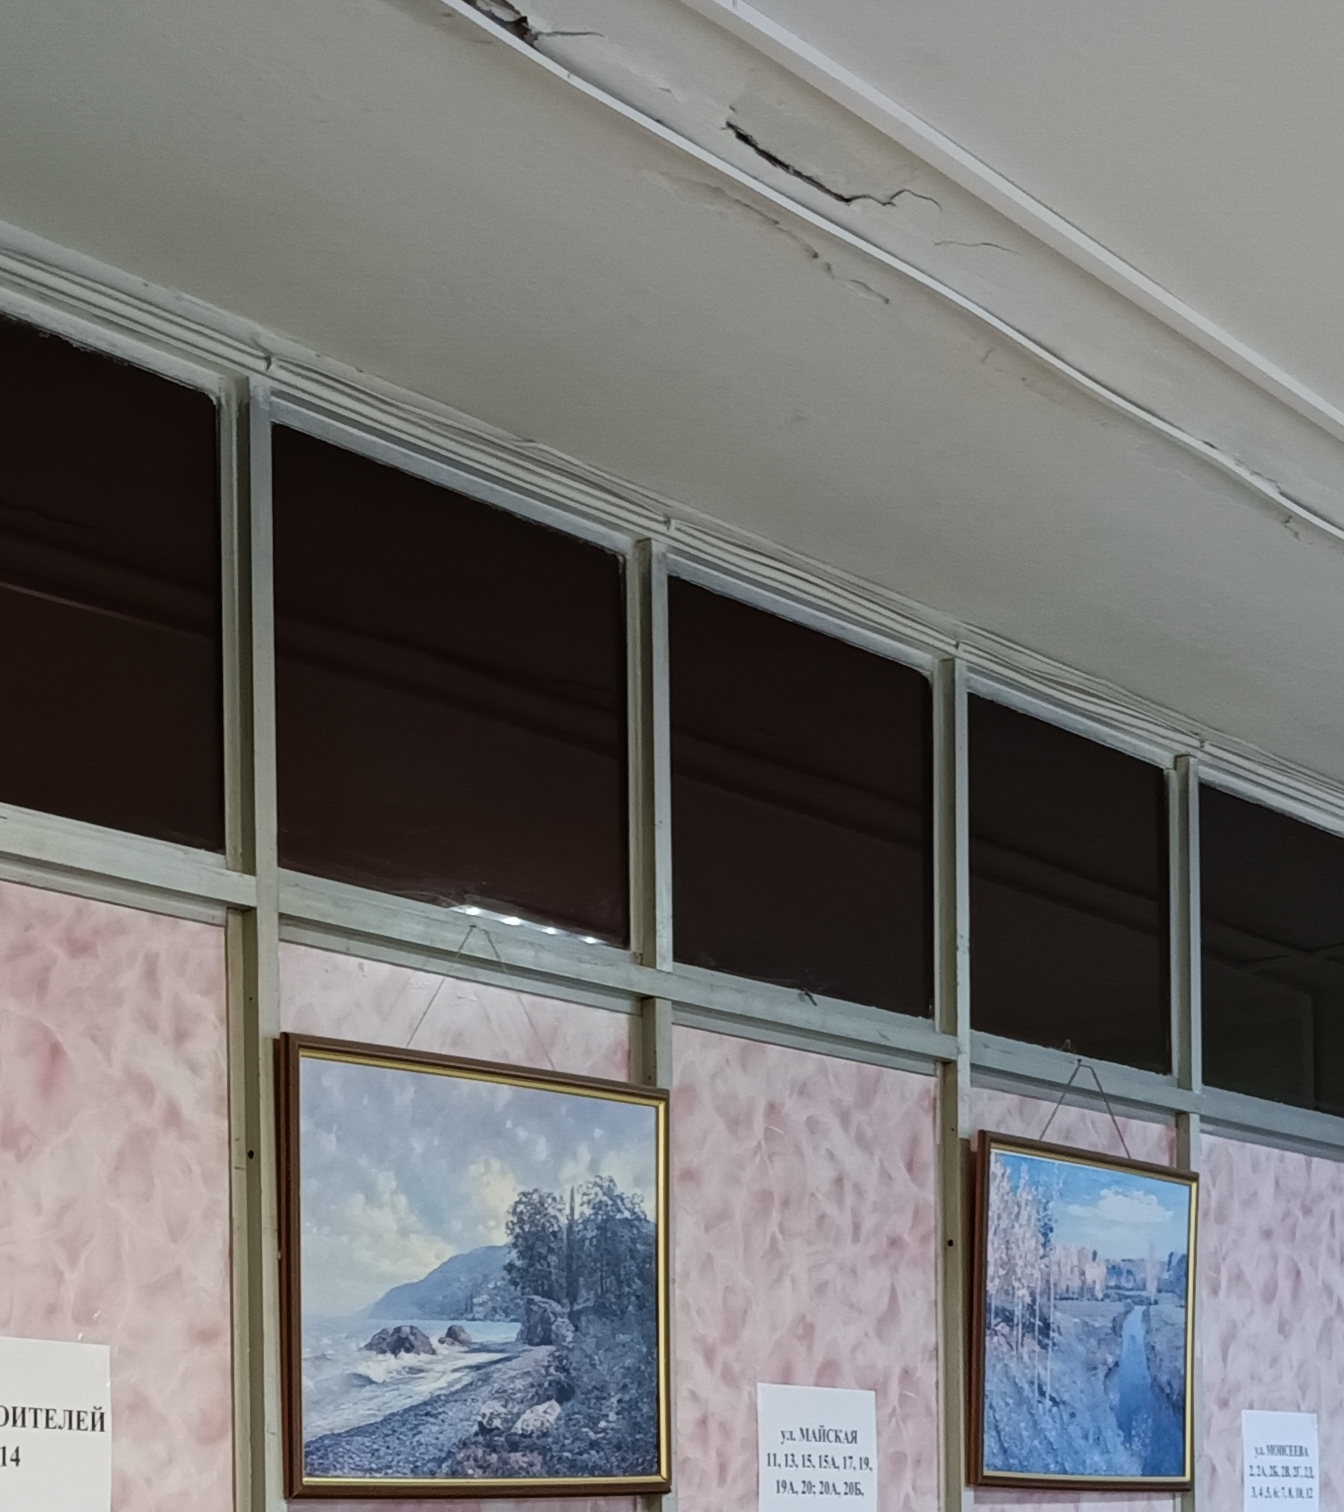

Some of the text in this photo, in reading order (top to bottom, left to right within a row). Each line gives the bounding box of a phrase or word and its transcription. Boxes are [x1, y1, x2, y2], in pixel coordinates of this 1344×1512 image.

[780, 1425, 858, 1445] ул. МАЙСКАЯ
[0, 1445, 21, 1467] 14
[766, 1453, 873, 1472] 11, 13, 15, 15А, 17, 19,
[776, 1479, 798, 1495] 19А,
[819, 1481, 841, 1496] 20А,
